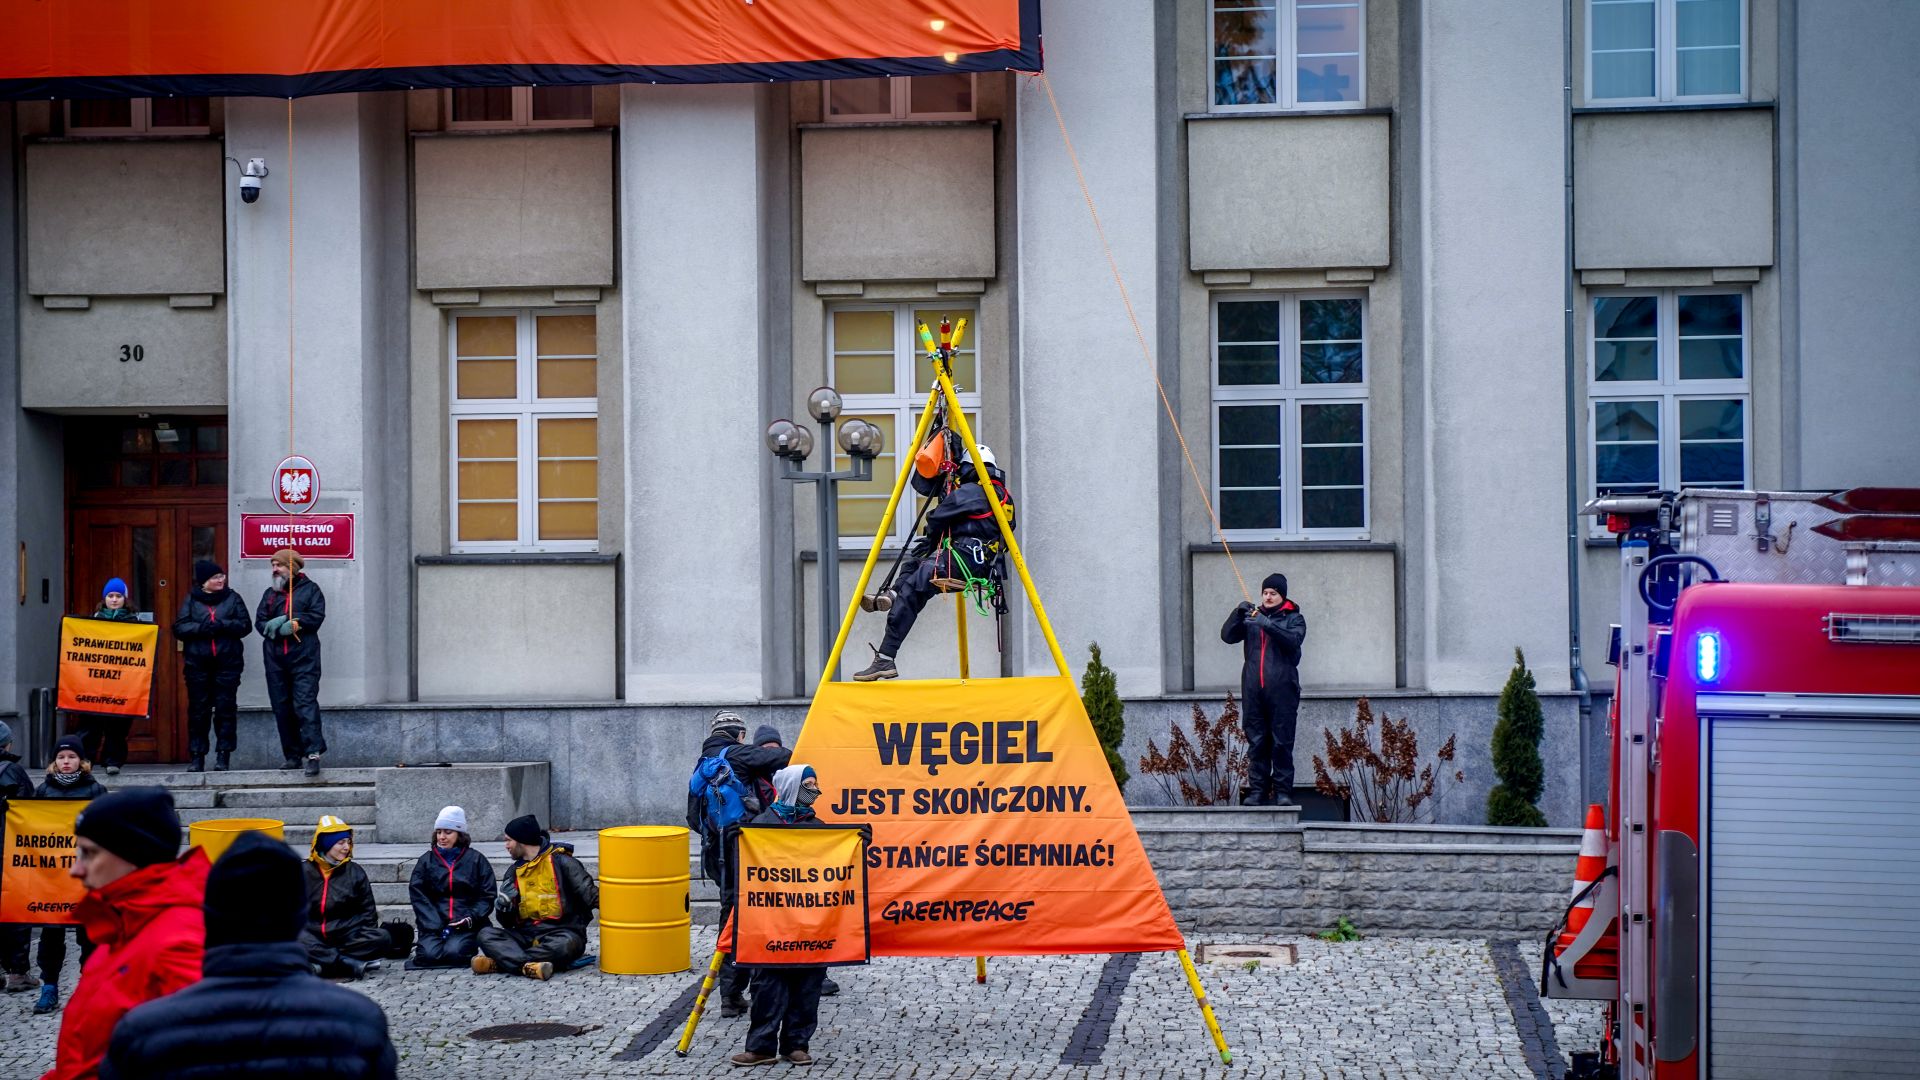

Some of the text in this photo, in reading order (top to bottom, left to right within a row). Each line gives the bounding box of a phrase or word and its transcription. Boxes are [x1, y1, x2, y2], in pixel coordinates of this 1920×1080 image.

[119, 344, 144, 362] 30
[260, 524, 334, 533] MINISTERSTWO
[262, 537, 331, 548] WĘGLA I GAZU
[72, 637, 144, 652] SPRAWIEDLIWA
[66, 651, 147, 668] TRANSFORMACJA
[88, 668, 122, 680] TERAZ!
[75, 694, 129, 706] GREENPEACE
[872, 720, 1054, 776] WĘGIEL
[831, 781, 1092, 815] JEST SKOŃCZONY.
[12, 854, 37, 868] BAL
[40, 855, 57, 868] NA
[866, 838, 1115, 869] STAŃCIE ŚCIEMNIAĆ!
[747, 865, 855, 883] FOSSILS OUT
[27, 901, 77, 913] GREENPE
[747, 890, 855, 908] RENEWABLES IN
[881, 900, 1035, 925] GREENPEACE
[765, 939, 836, 952] GREENPEACE
